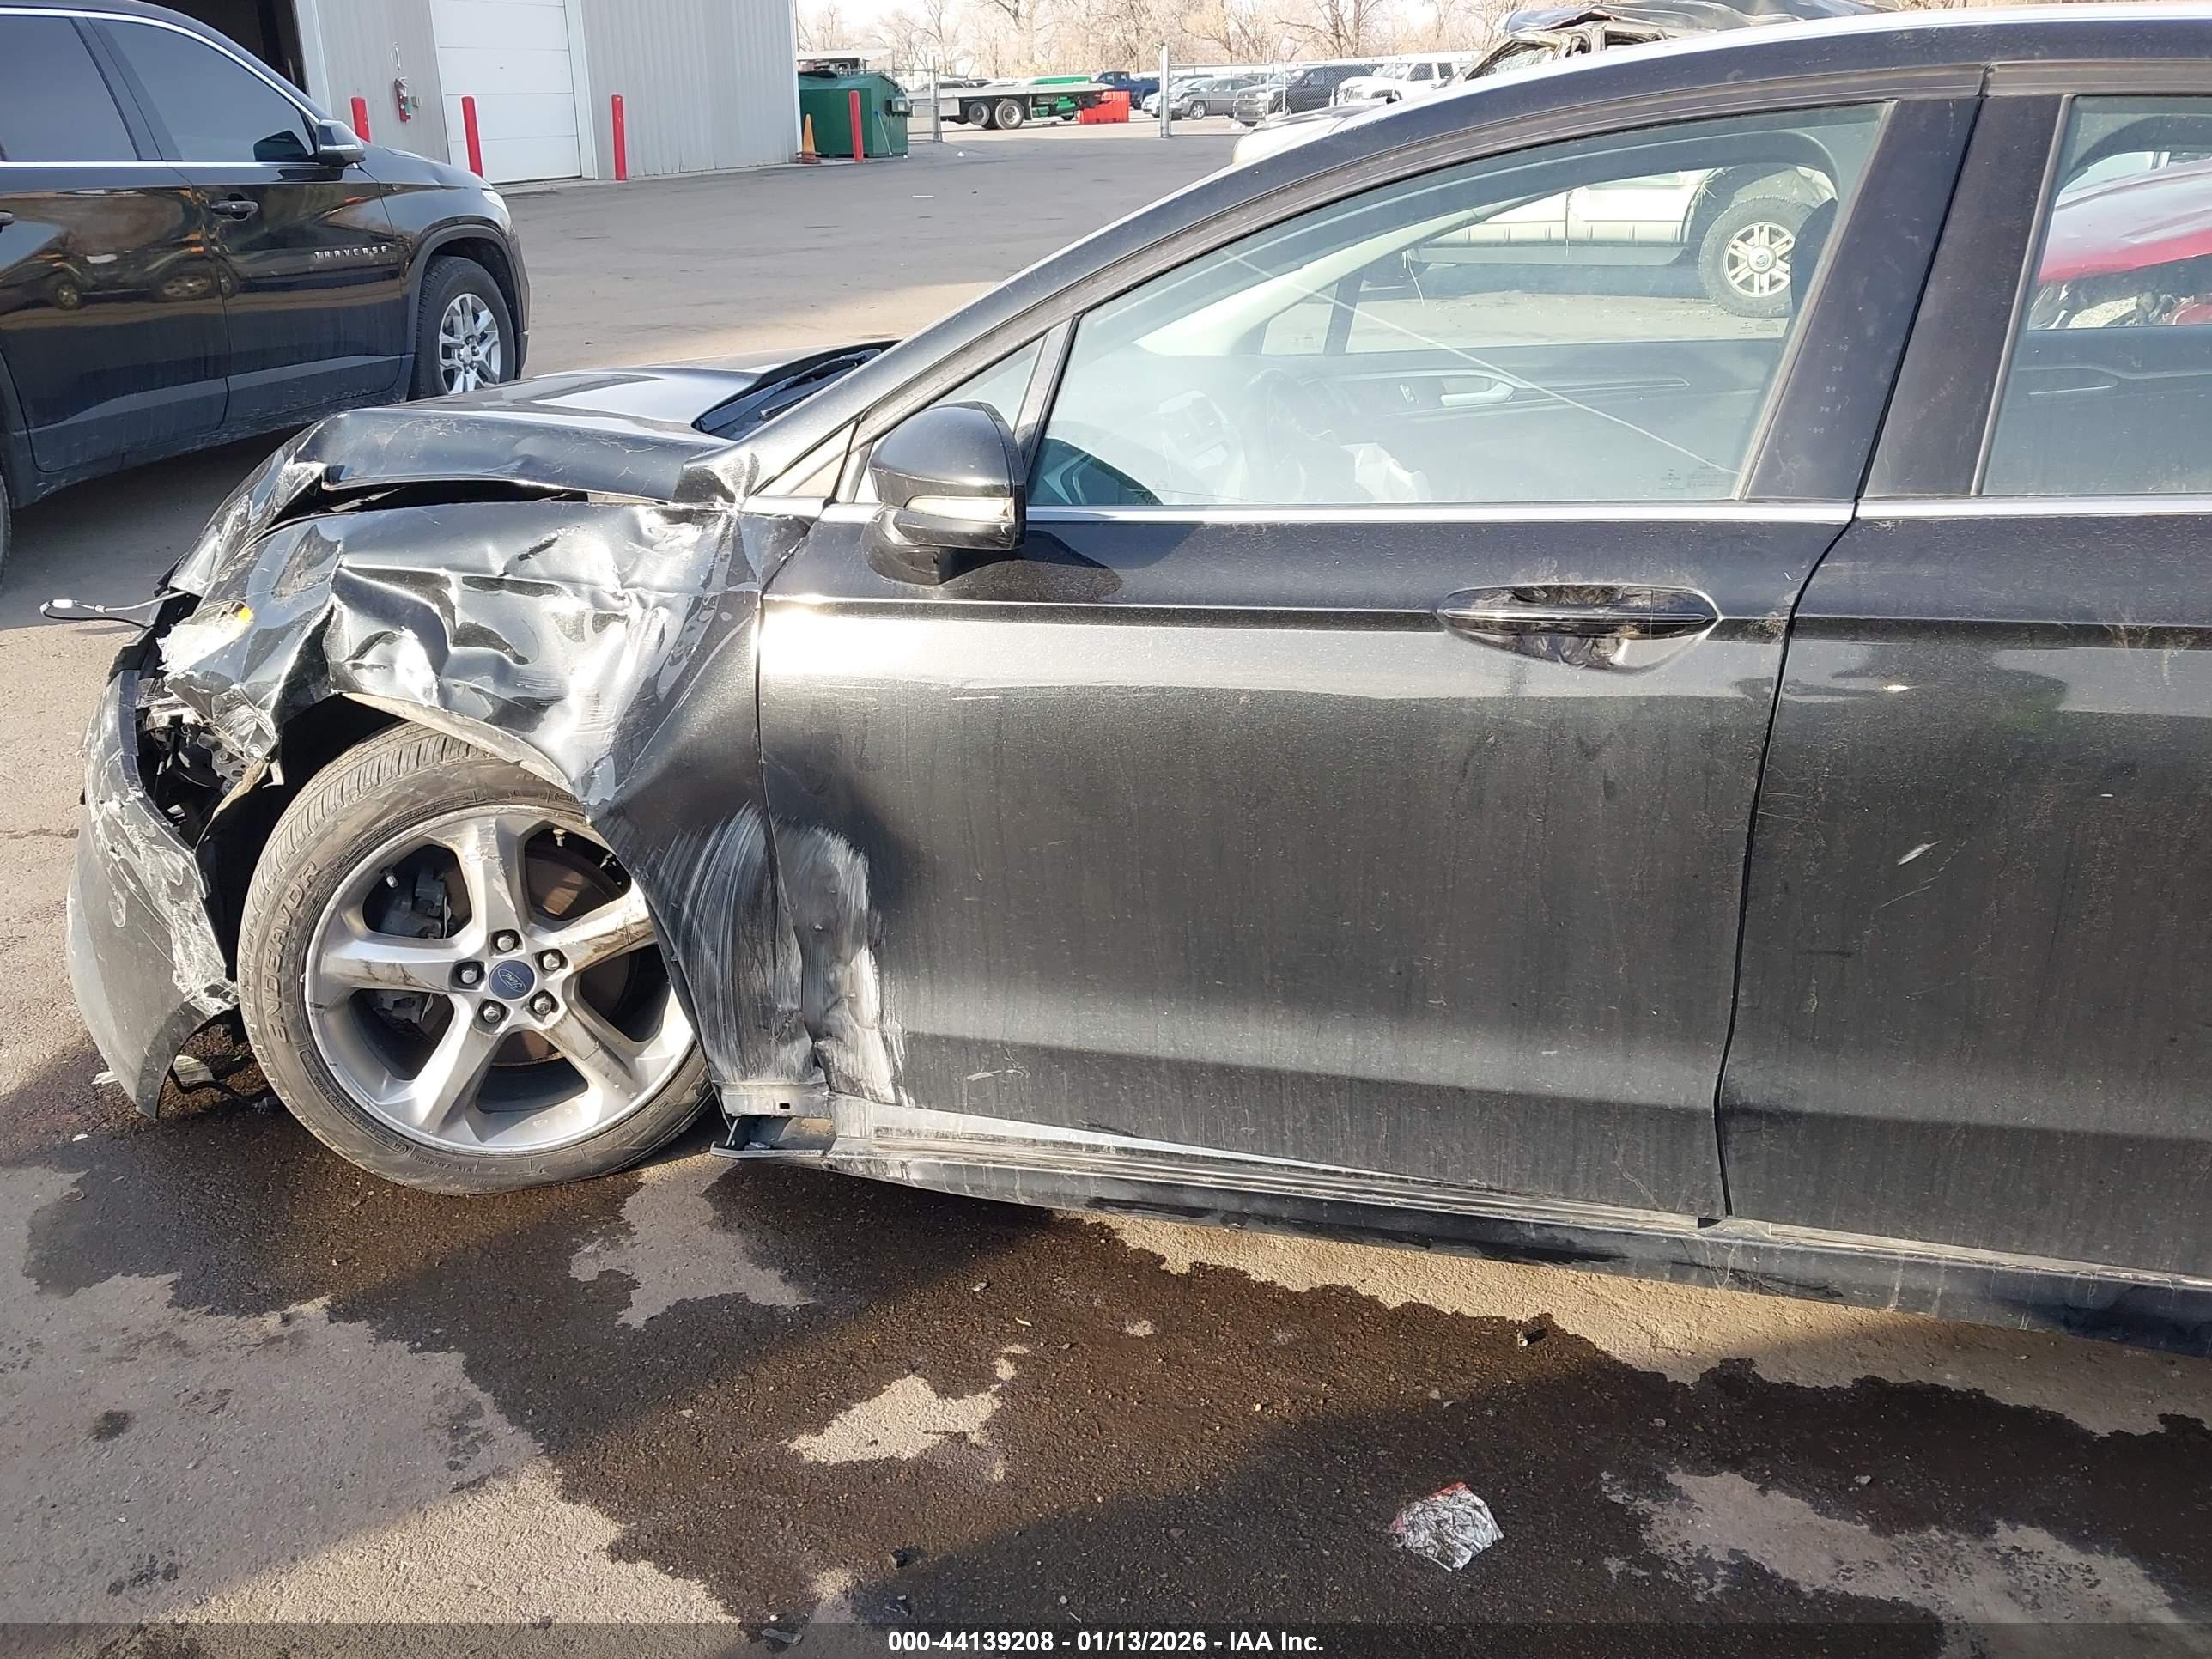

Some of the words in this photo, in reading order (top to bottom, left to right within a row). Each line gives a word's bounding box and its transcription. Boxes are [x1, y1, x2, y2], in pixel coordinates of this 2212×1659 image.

[314, 246, 388, 258] TRAVERSE
[264, 861, 320, 1043] ENDEAVOR
[501, 972, 523, 988] Ford
